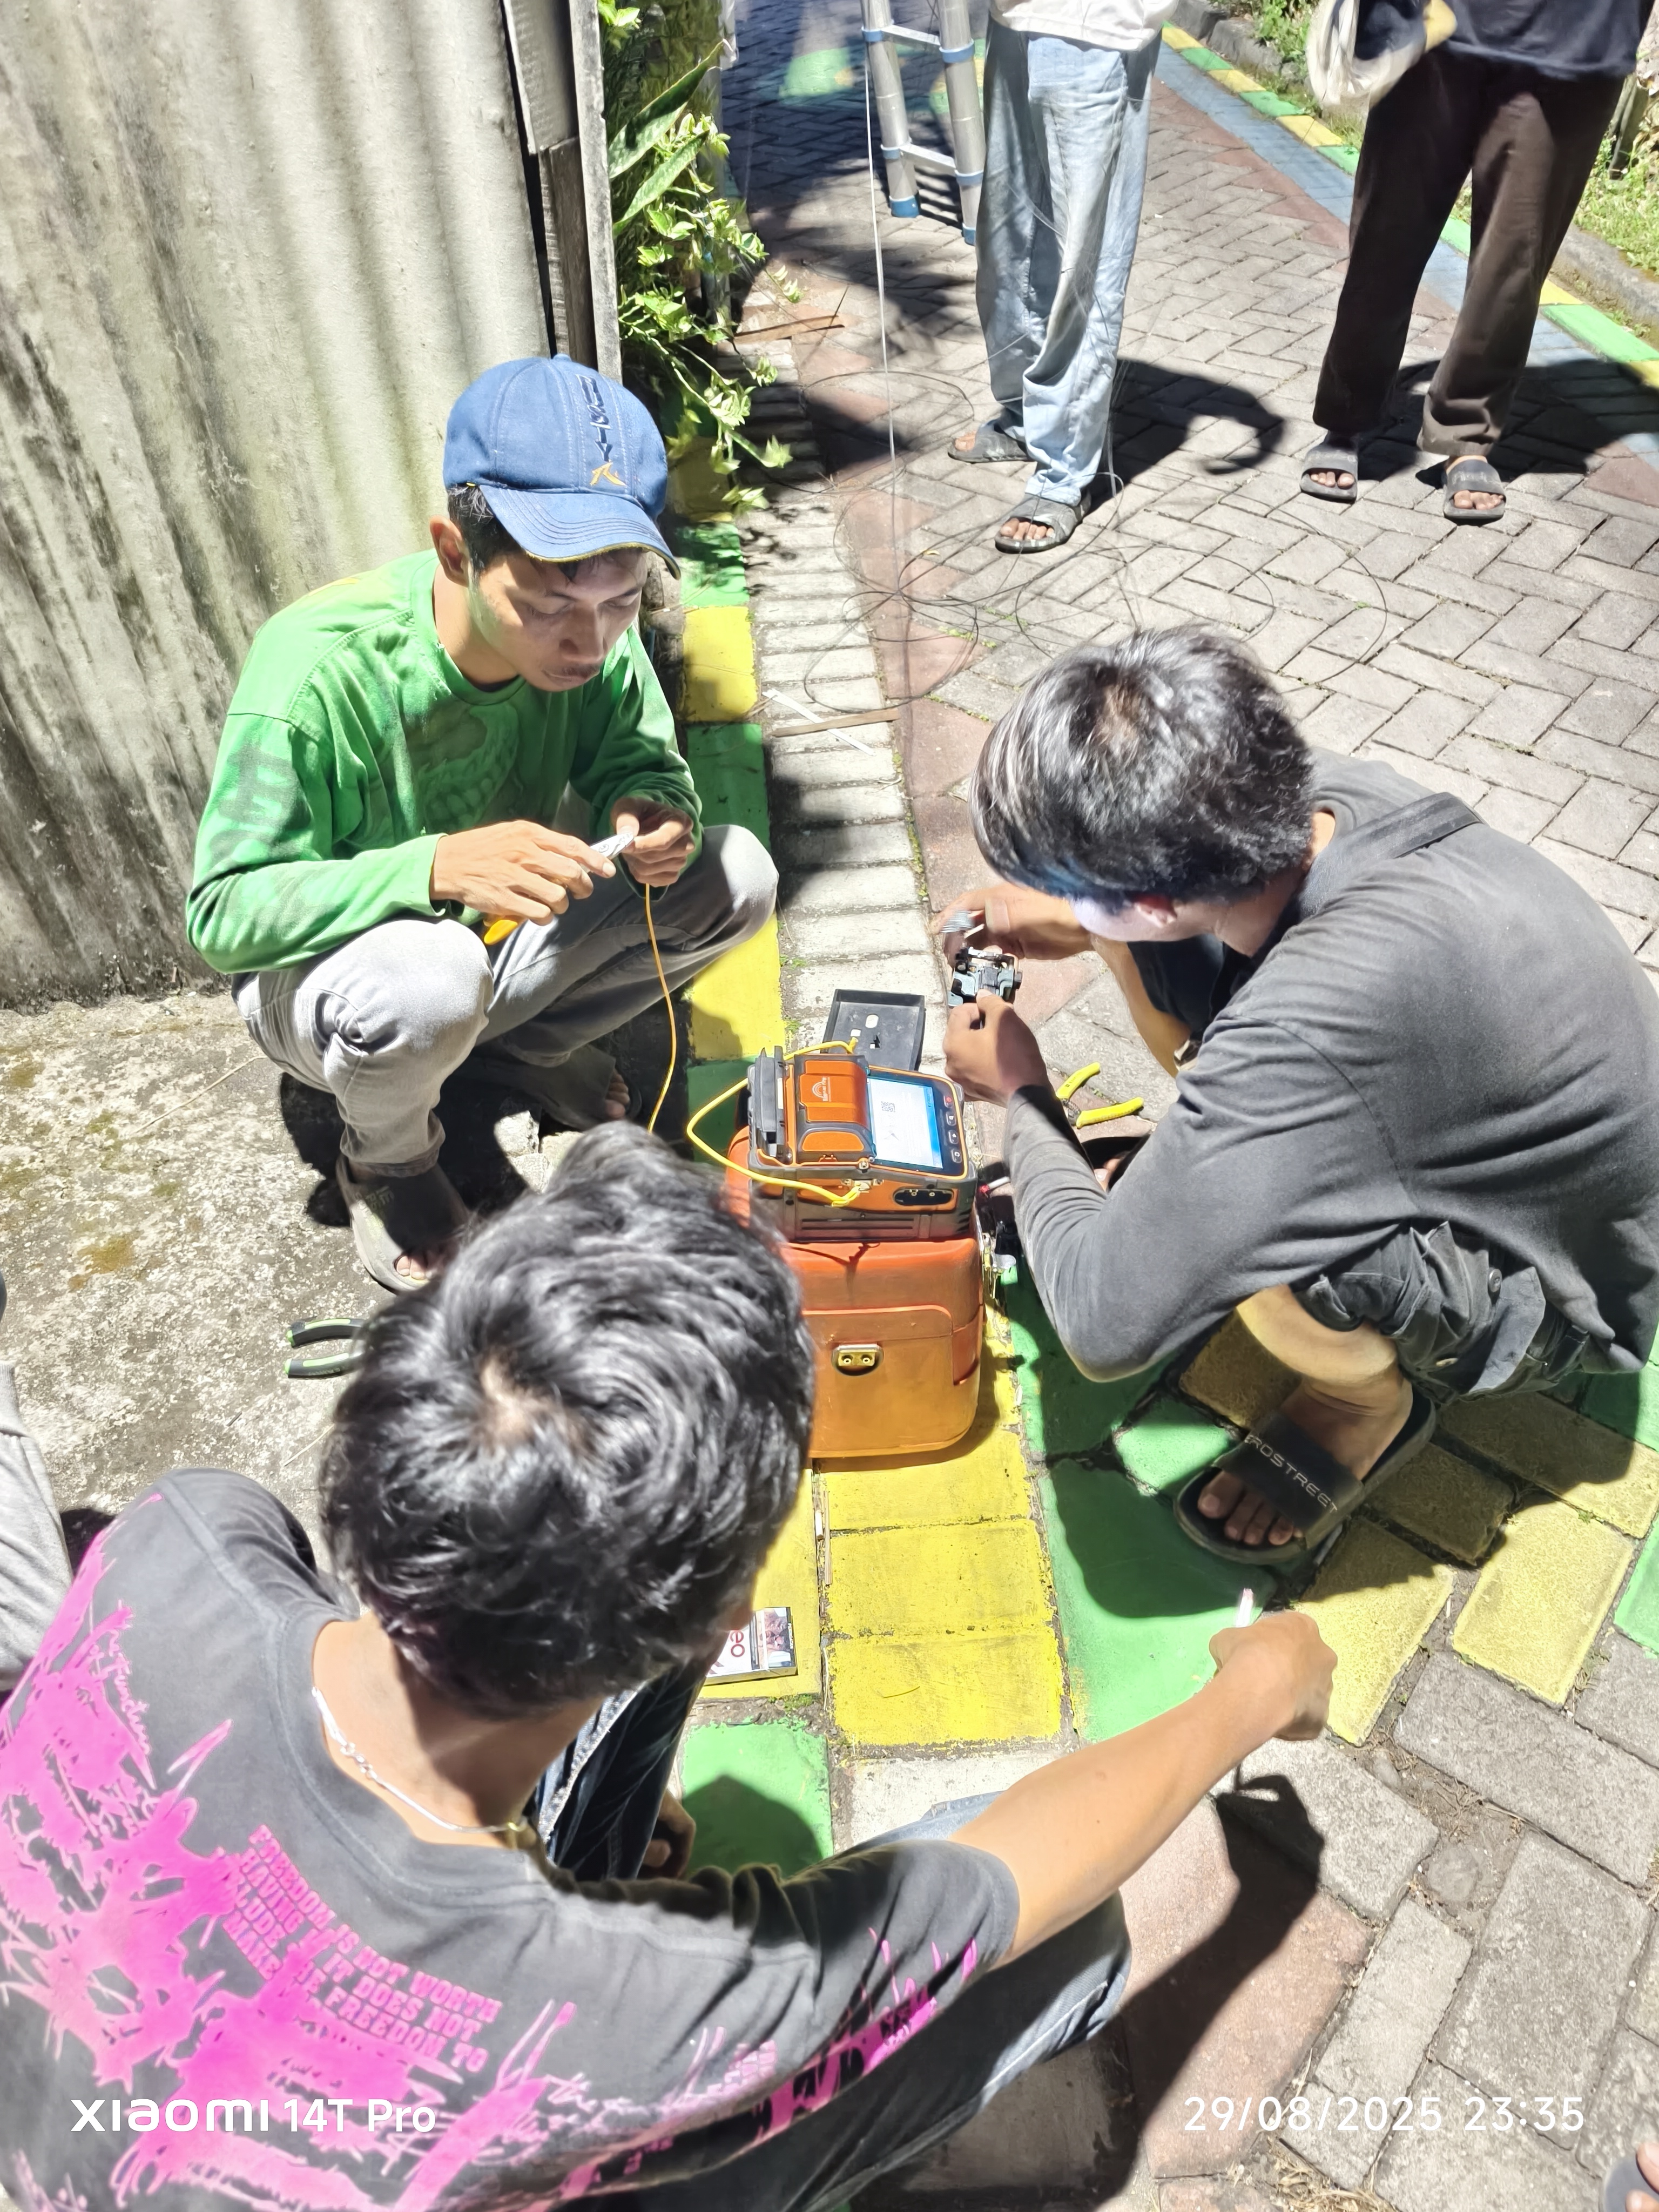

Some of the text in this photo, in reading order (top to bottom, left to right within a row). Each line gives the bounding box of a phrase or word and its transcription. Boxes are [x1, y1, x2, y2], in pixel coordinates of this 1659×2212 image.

[222, 1910, 283, 1981] MAKE
[248, 1824, 336, 1931] FREEDOM
[353, 1945, 409, 1985] NOT
[409, 1971, 503, 2023] WORTH
[324, 1985, 448, 2061] FREEDOM
[450, 2042, 488, 2073] TO
[352, 1975, 424, 2022] DOES
[424, 2006, 482, 2042] NOT
